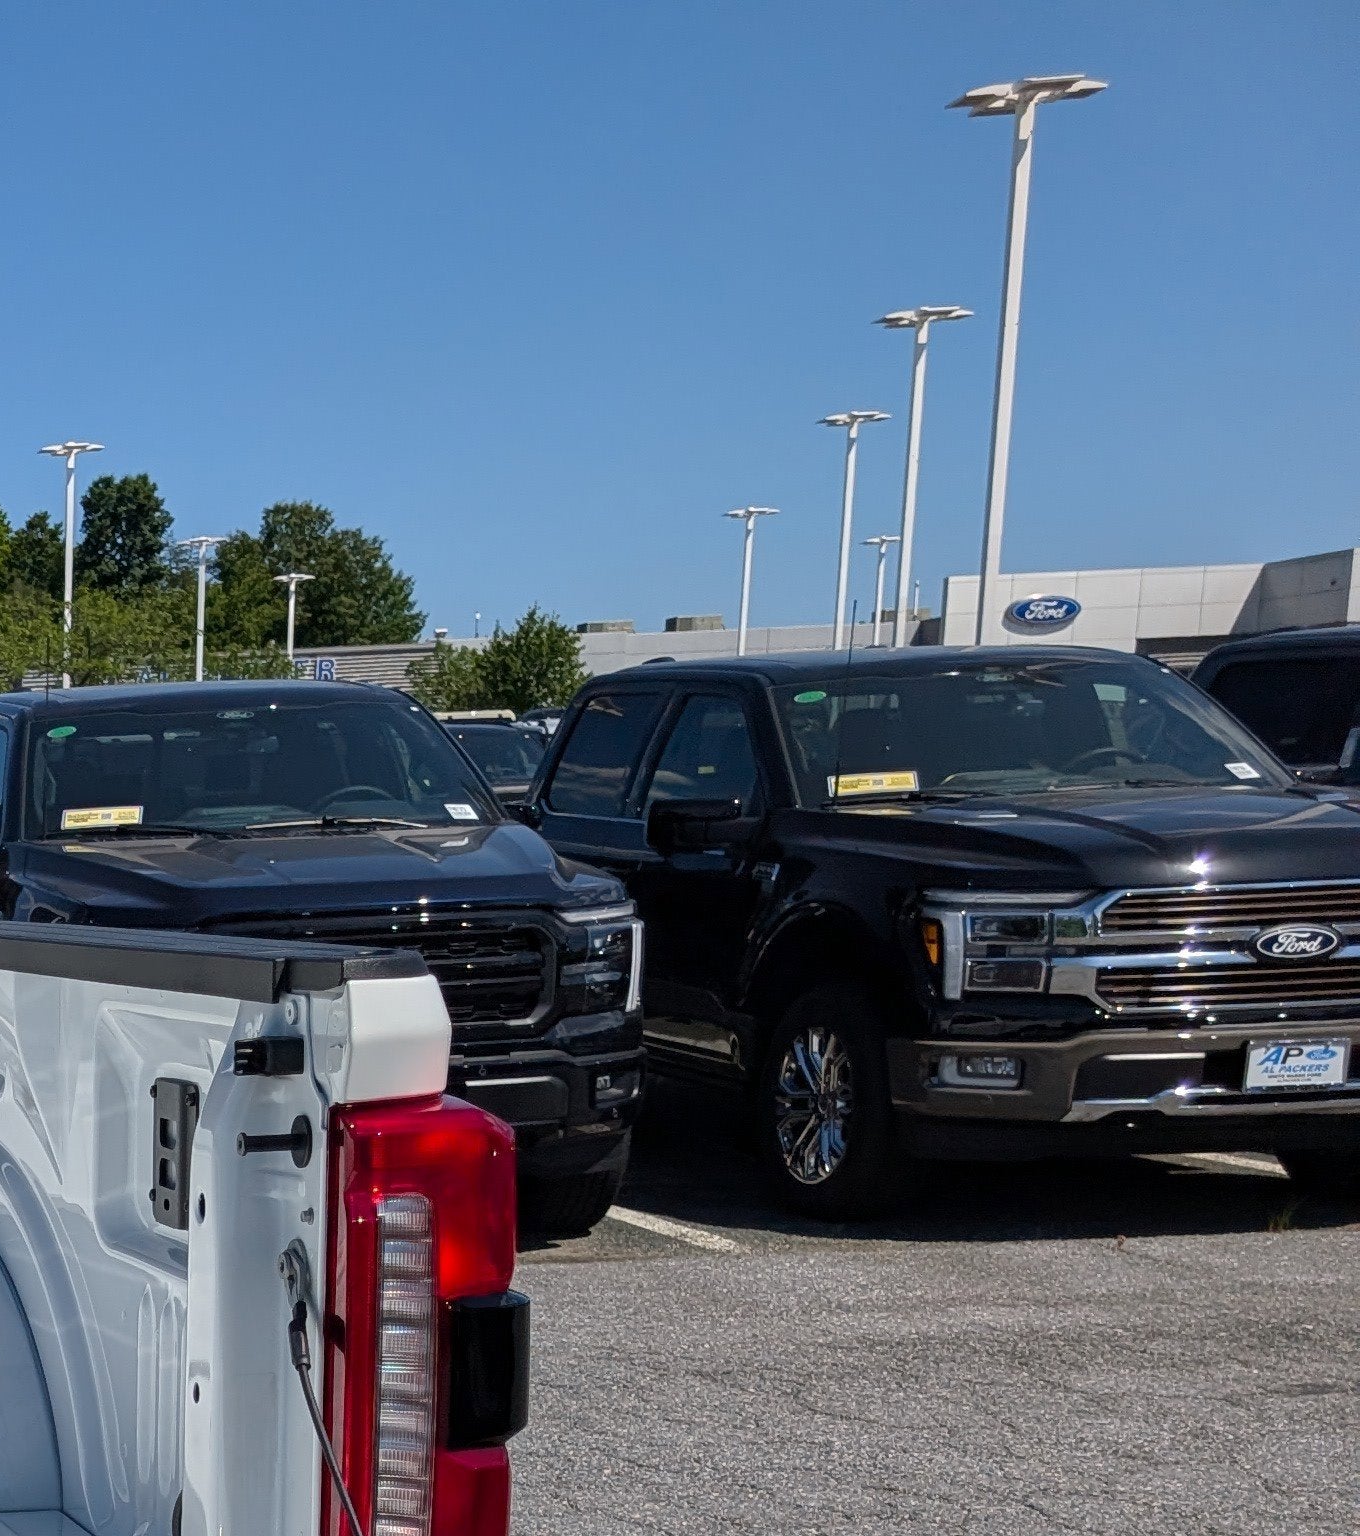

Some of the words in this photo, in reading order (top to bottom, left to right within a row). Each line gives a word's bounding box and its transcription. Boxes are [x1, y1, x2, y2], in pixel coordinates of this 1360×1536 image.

[1024, 600, 1069, 620] Ford
[1271, 932, 1324, 953] Ford
[1257, 1046, 1303, 1066] AP
[1278, 1064, 1330, 1073] PACKERS
